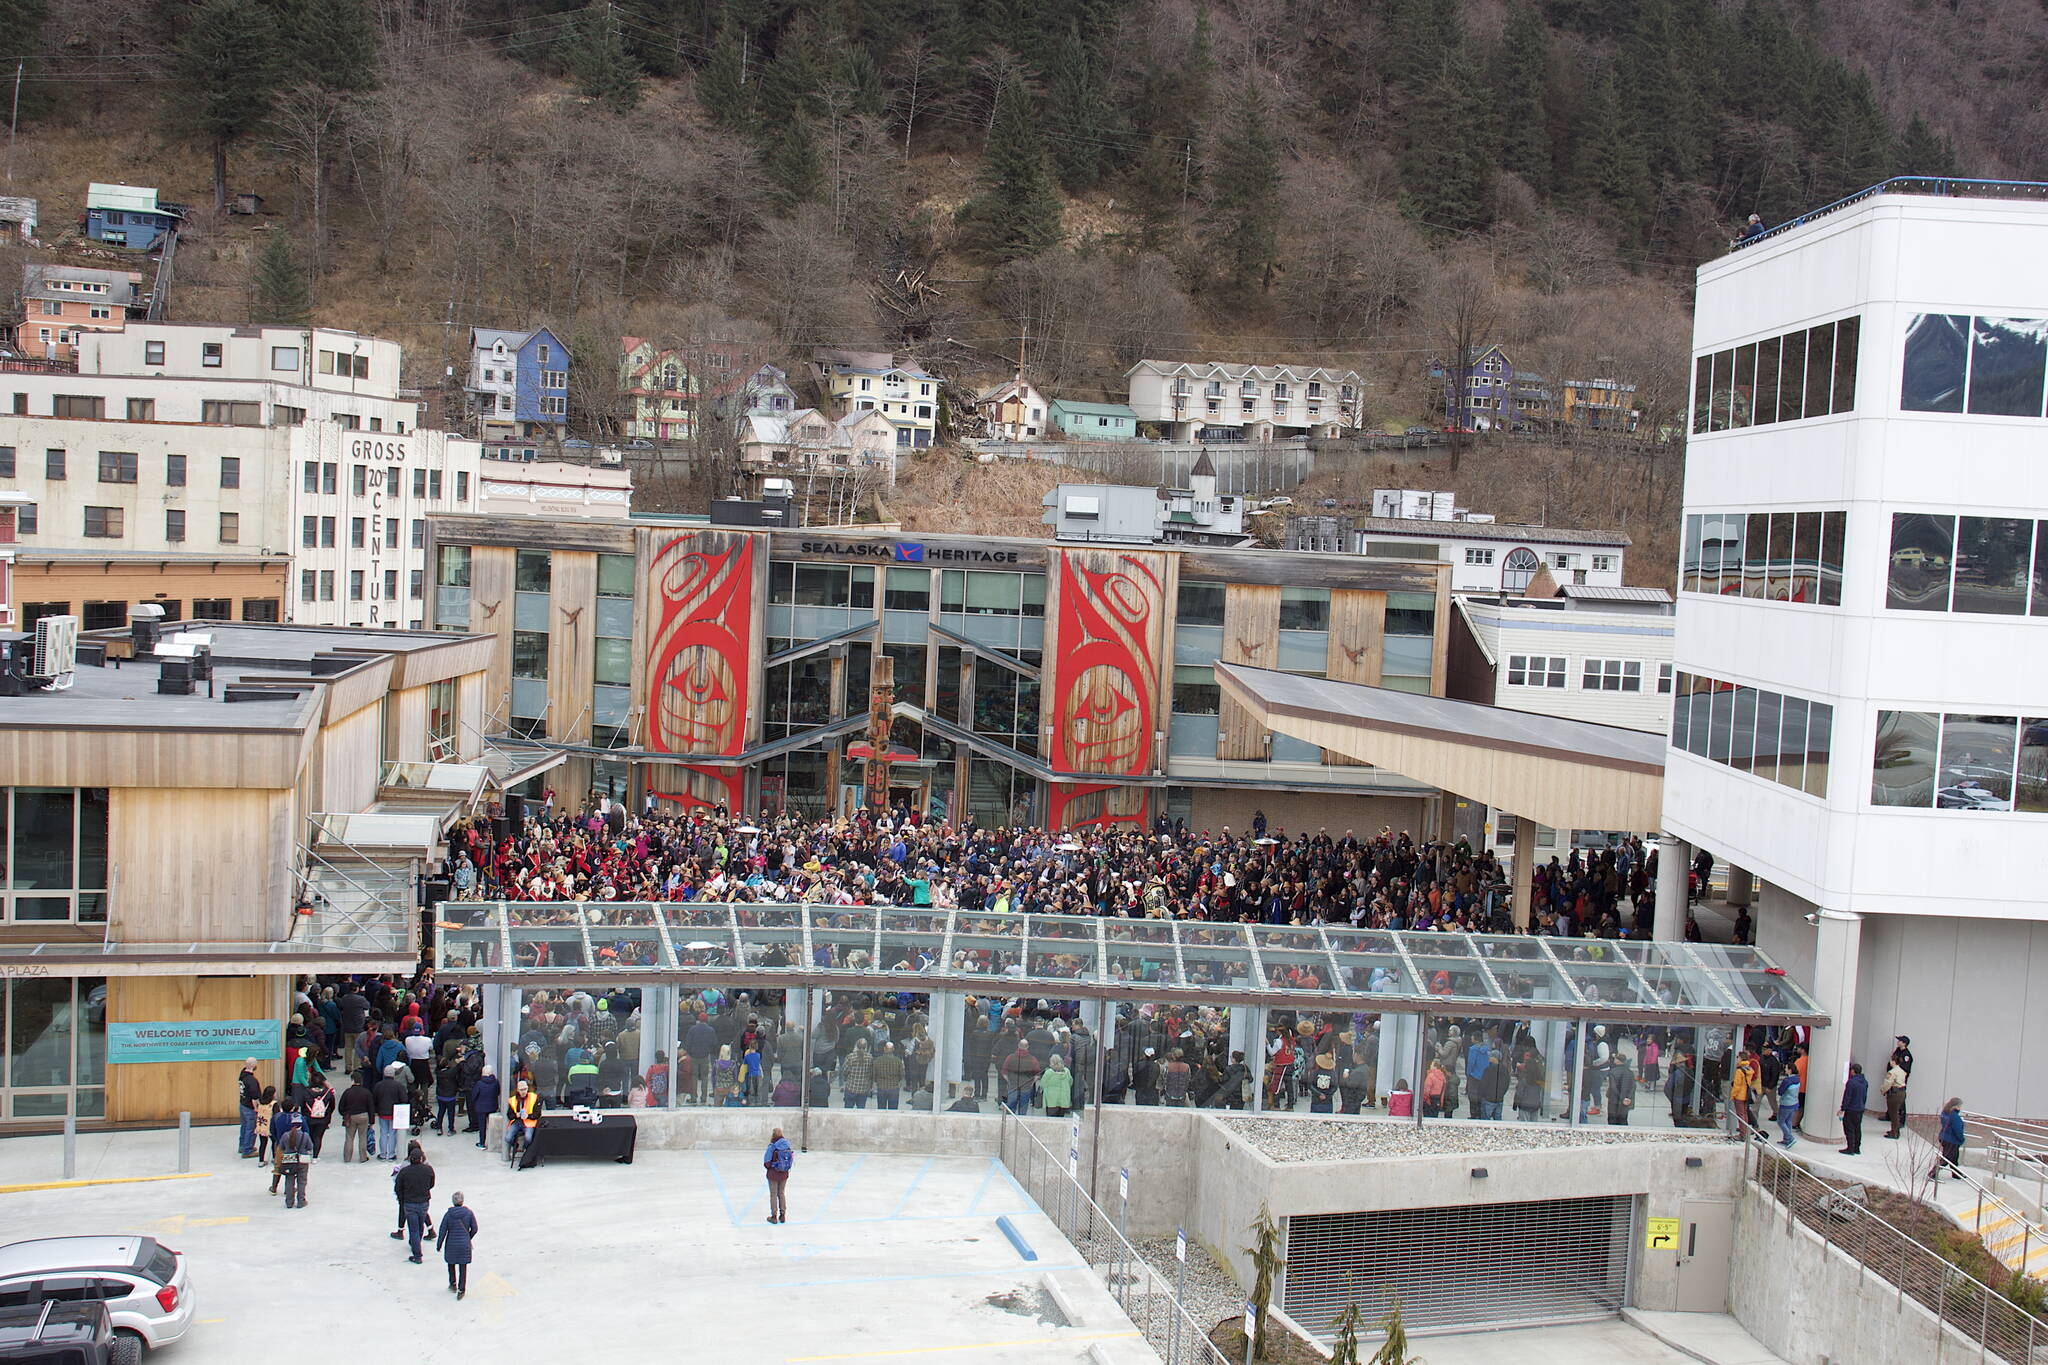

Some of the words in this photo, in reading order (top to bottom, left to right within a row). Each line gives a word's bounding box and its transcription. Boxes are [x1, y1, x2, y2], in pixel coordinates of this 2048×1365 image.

[352, 440, 405, 461] GROSS
[368, 468, 388, 487] 20th
[801, 542, 891, 557] SEALASKA
[928, 548, 1018, 563] HERITAGE
[7, 965, 49, 976] PLAZA
[135, 1029, 191, 1039] WELCOME
[196, 1029, 209, 1037] TO
[212, 1028, 256, 1037] JUNEAU
